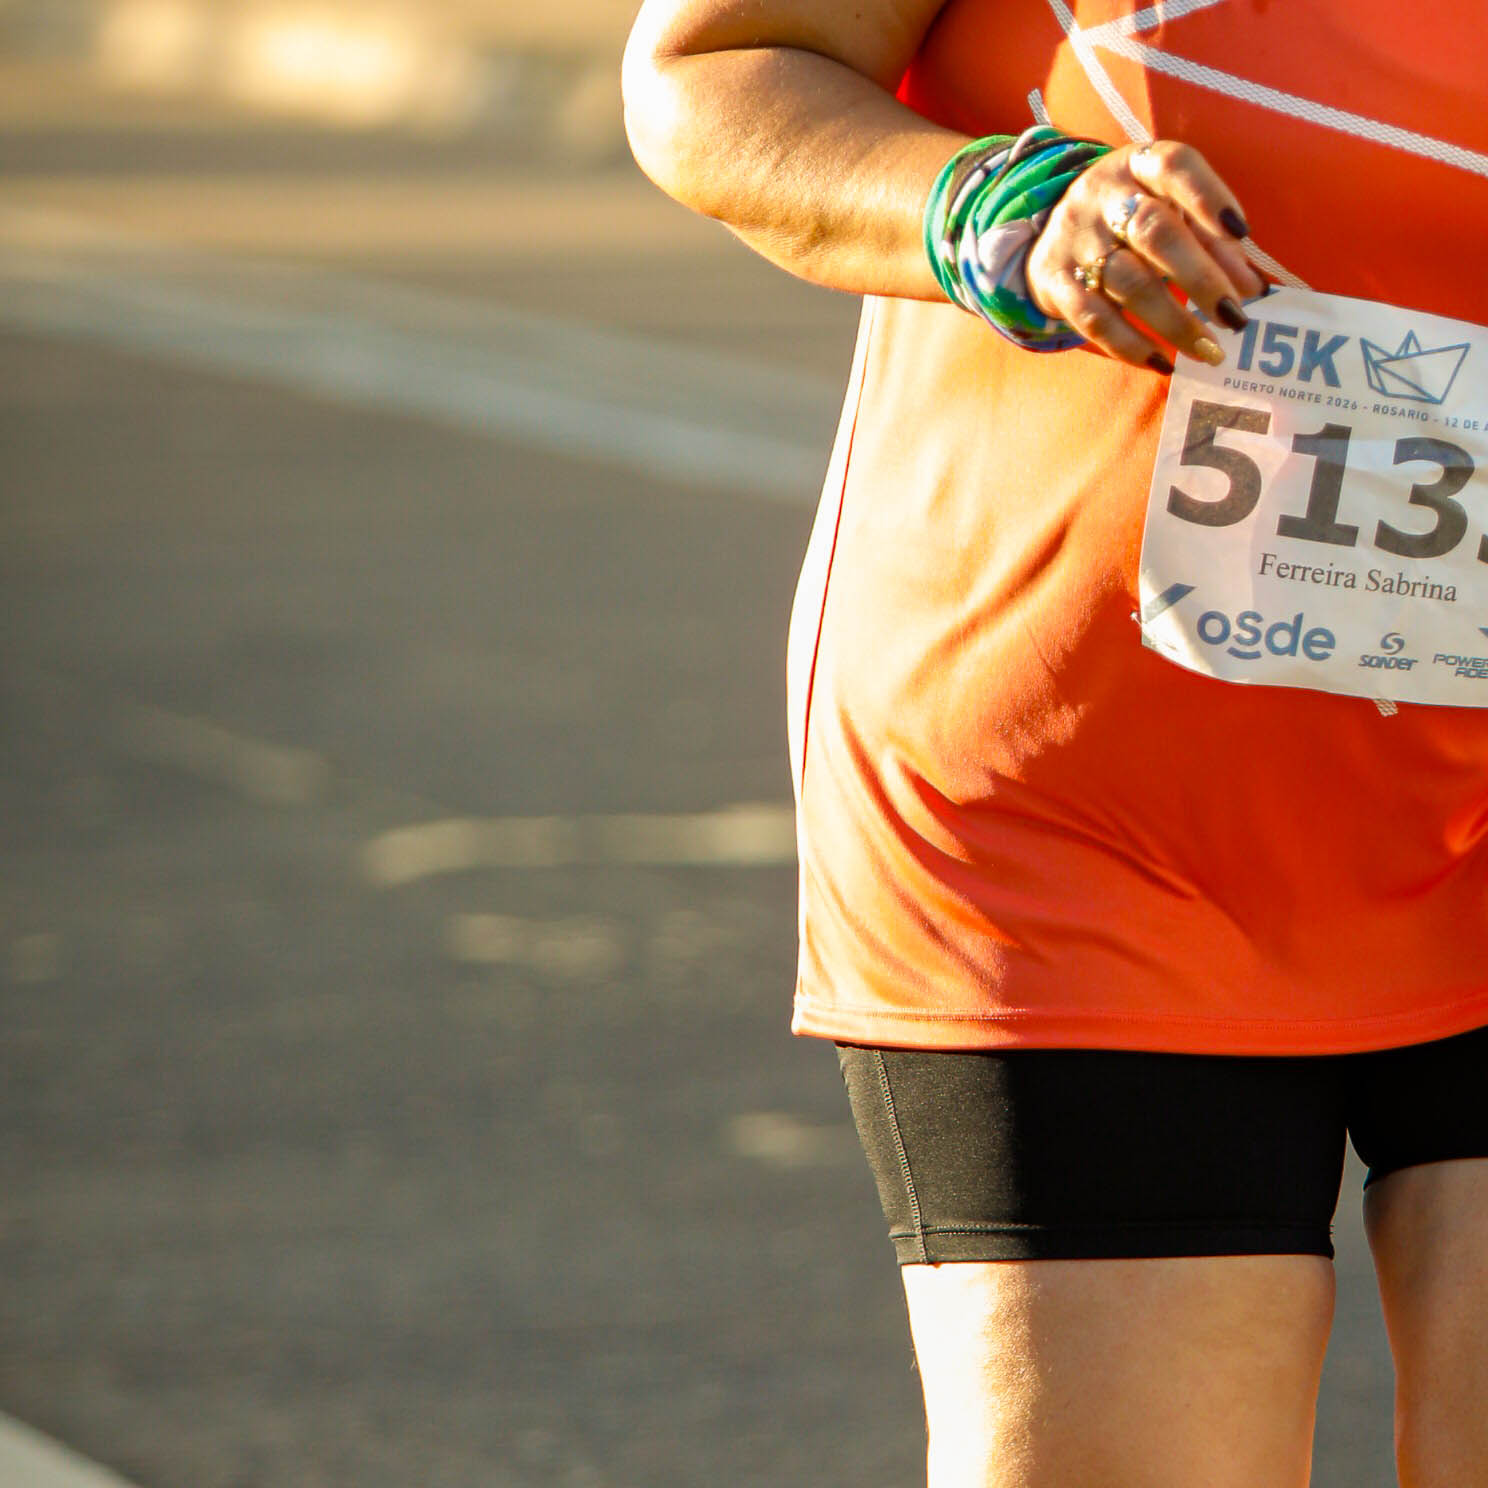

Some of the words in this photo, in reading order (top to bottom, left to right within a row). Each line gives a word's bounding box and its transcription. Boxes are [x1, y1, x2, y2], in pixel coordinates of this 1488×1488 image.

[1234, 318, 1350, 388] 15K
[1223, 377, 1275, 394] PUERTO
[1279, 387, 1322, 403] NORTE
[1326, 396, 1358, 410] 2026
[1372, 404, 1429, 422] ROSARIO
[1444, 417, 1458, 429] 12
[1463, 419, 1479, 431] DE
[1257, 552, 1357, 589] Ferreira
[1365, 568, 1457, 602] Sabrina
[1197, 610, 1336, 661] osde
